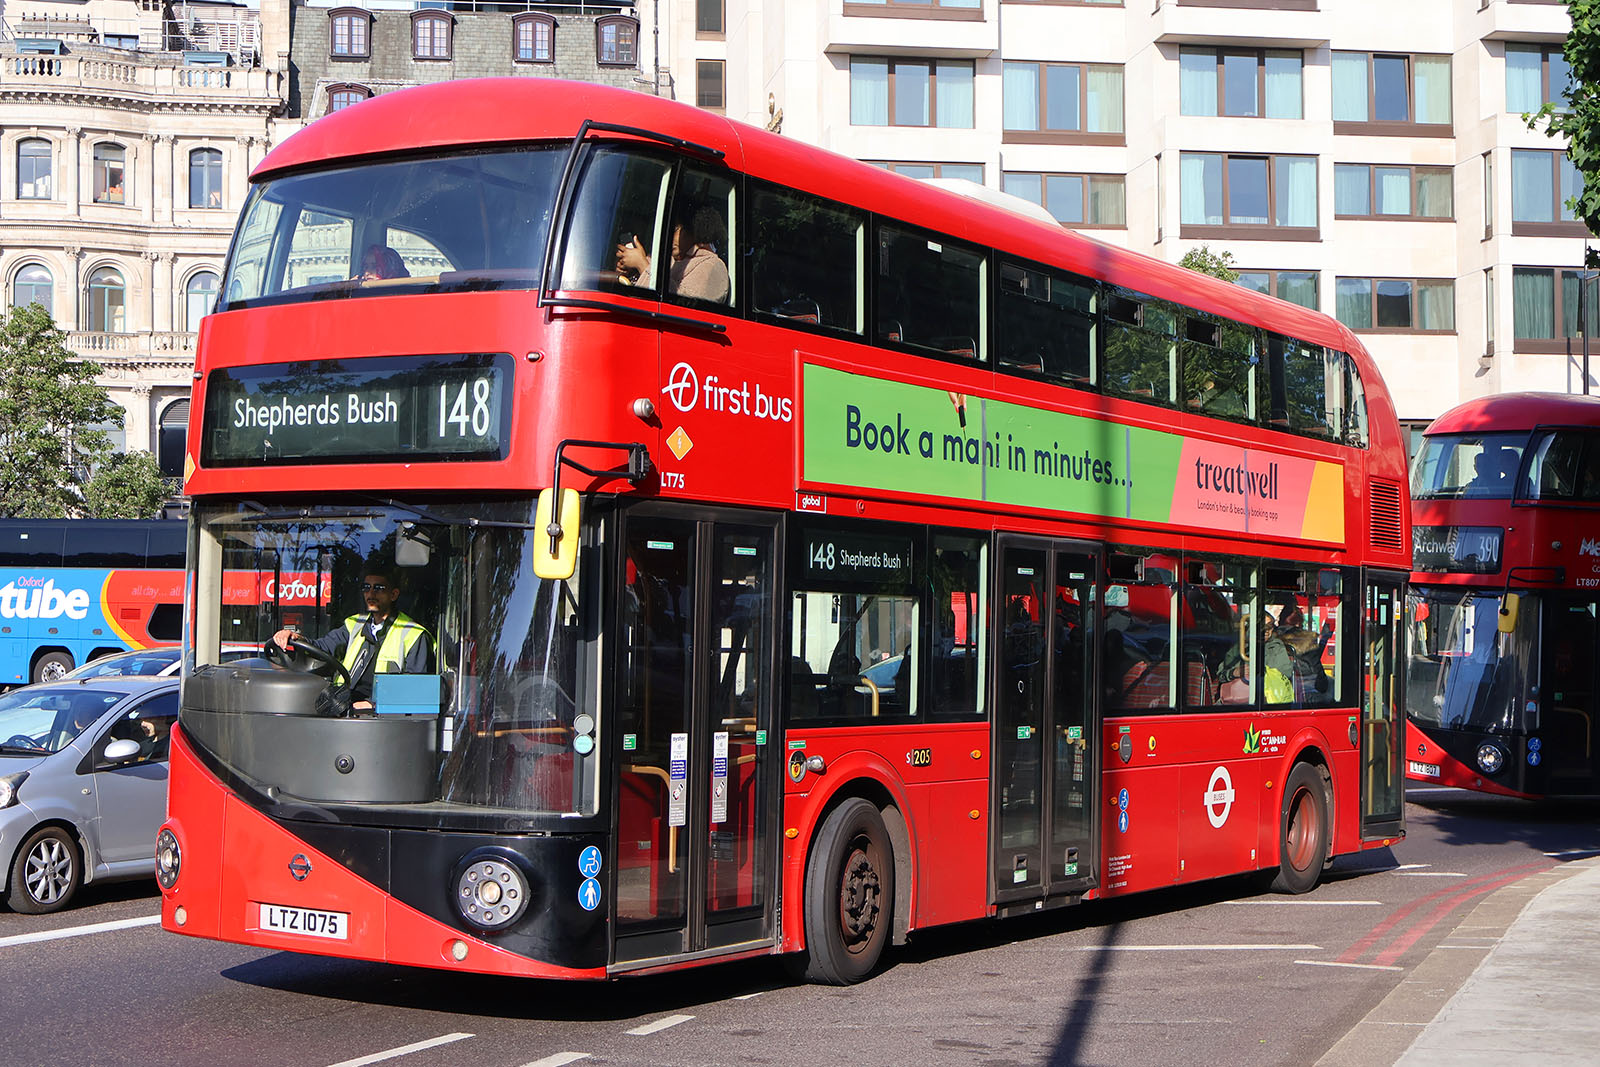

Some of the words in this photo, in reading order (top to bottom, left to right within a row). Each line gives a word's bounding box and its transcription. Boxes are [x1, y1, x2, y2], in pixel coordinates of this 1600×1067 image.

[439, 377, 490, 437] 148
[703, 376, 750, 415] first
[754, 384, 792, 422] bus
[234, 394, 340, 434] Shepherds
[347, 392, 398, 424] Bush
[846, 404, 910, 455] Book
[919, 431, 933, 458] a
[943, 432, 1000, 468] mani
[1008, 434, 1026, 472] in
[661, 472, 685, 489] LT75
[1195, 456, 1278, 500] treatwell
[802, 495, 821, 508] global
[1197, 499, 1219, 511] London's
[809, 542, 836, 570] 148
[840, 549, 881, 571] Shepherds
[883, 552, 901, 569] Bush
[1414, 539, 1460, 560] Archway
[1479, 536, 1500, 562] 390
[18, 576, 45, 587] Oxford
[1576, 578, 1600, 587] LT807
[0, 578, 90, 619] tube
[914, 749, 931, 765] 205
[269, 908, 299, 930] LTZ
[303, 911, 338, 934] 1075
